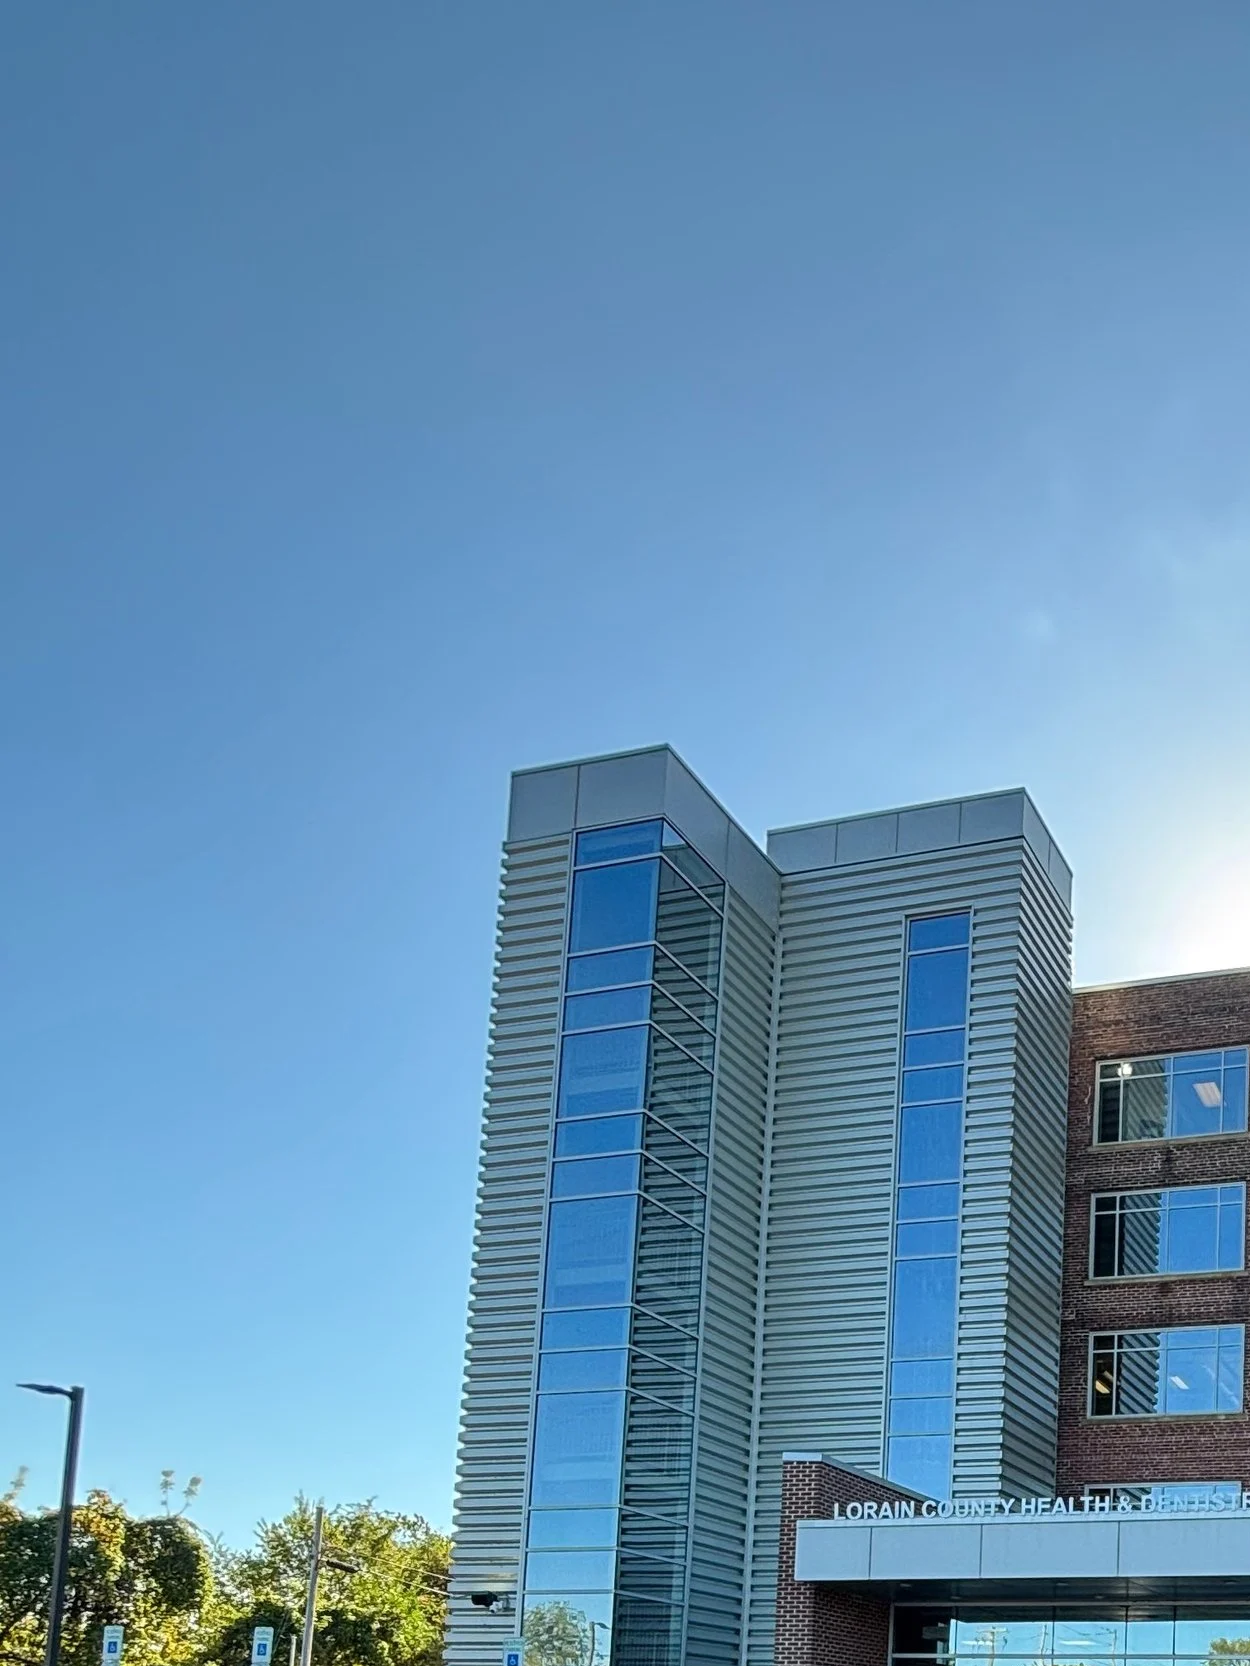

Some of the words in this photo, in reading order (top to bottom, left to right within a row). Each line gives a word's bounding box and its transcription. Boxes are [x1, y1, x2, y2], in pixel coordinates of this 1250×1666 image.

[834, 1500, 915, 1520] LORAIN
[921, 1498, 1015, 1518] COUNTY
[1021, 1496, 1109, 1516] HEALTH
[1117, 1496, 1133, 1514] &
